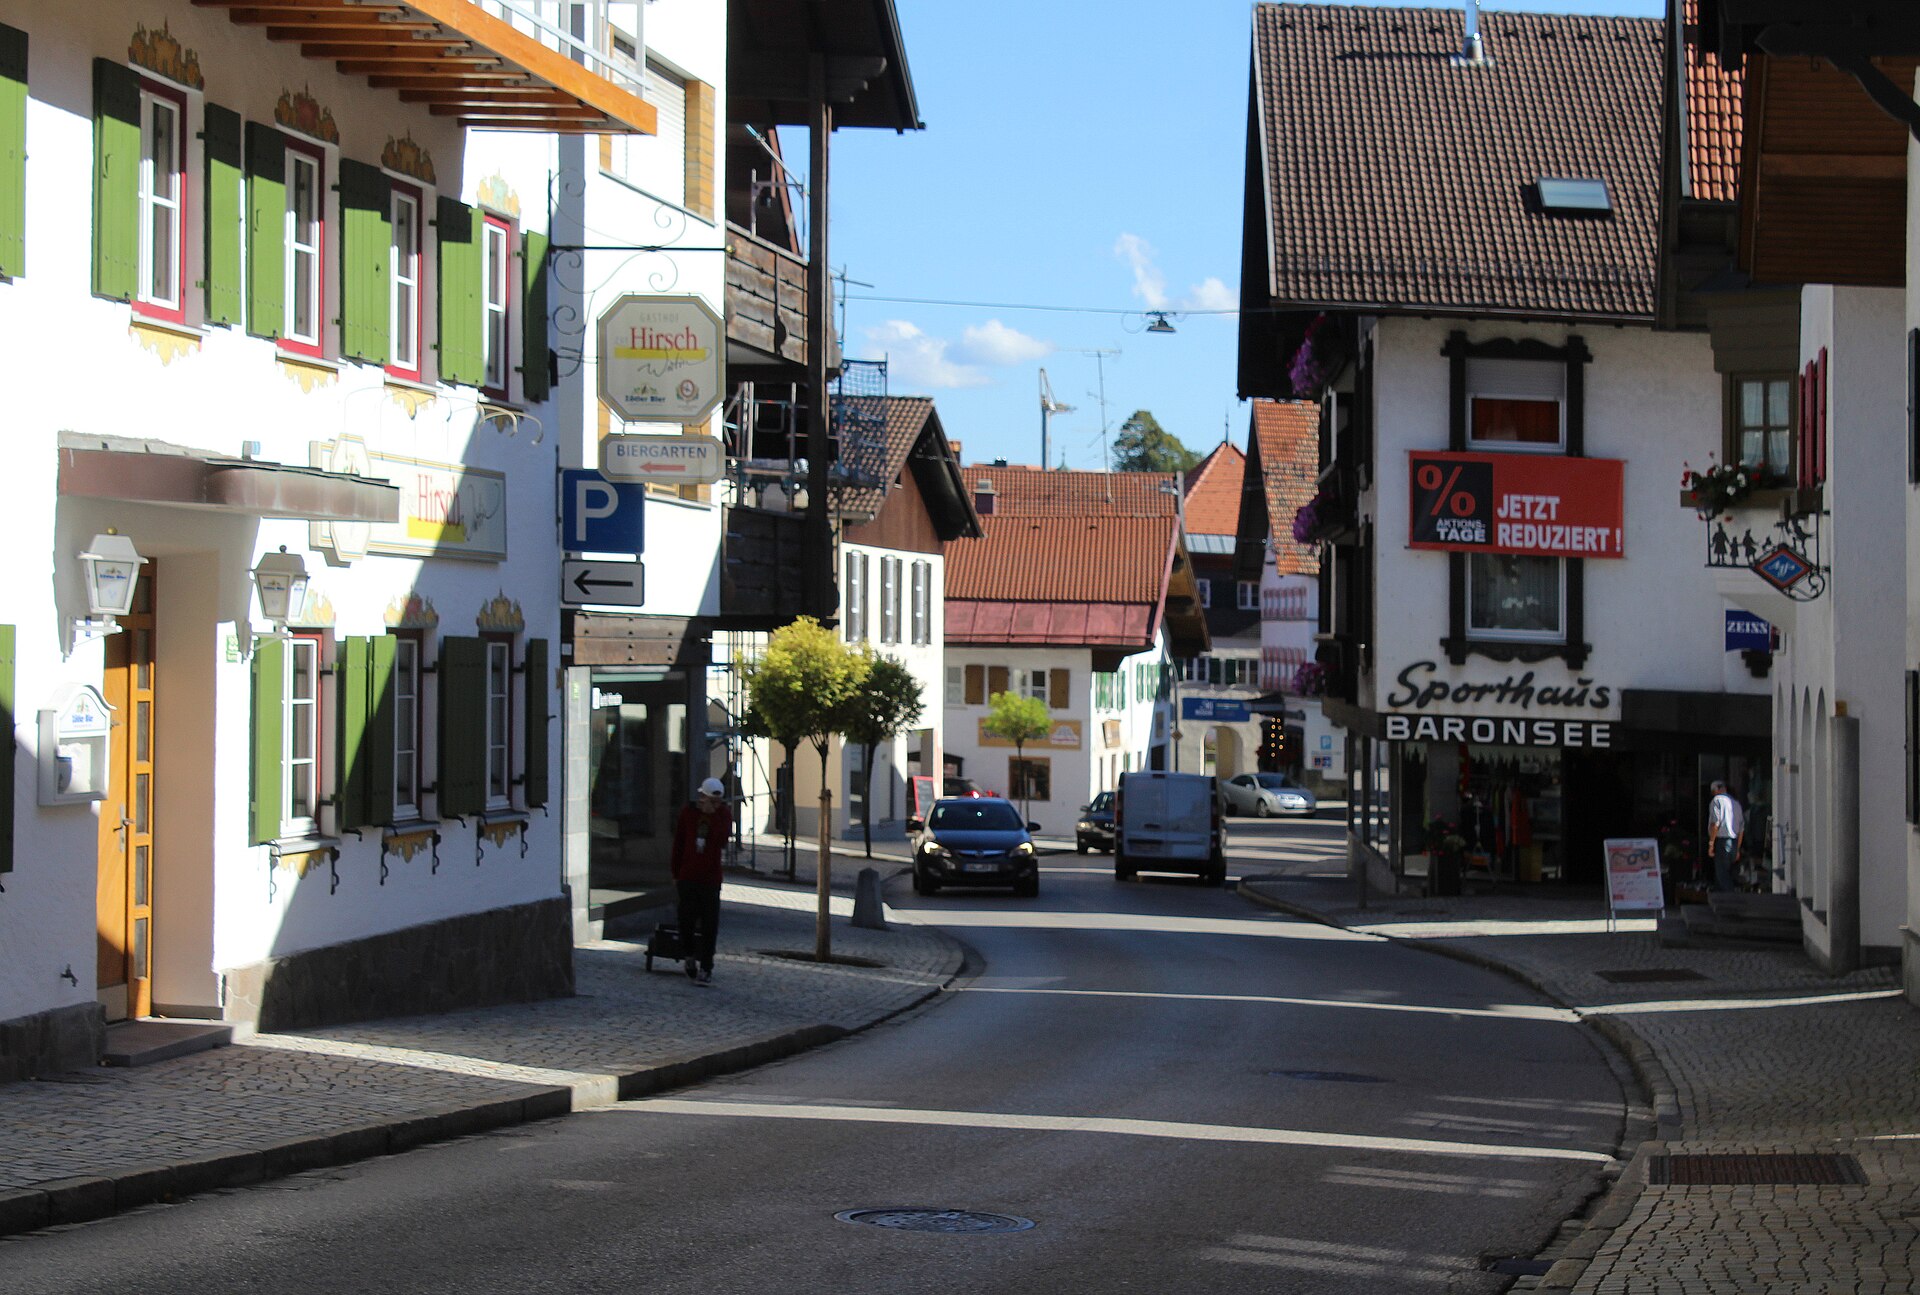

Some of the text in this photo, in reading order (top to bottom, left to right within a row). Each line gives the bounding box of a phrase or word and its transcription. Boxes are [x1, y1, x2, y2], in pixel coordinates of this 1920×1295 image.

[630, 326, 699, 351] Hirsch
[617, 444, 707, 459] BIERGARTEN
[417, 474, 460, 528] Hirsch
[1417, 465, 1476, 517] %
[576, 480, 618, 542] P
[1497, 495, 1560, 521] JETZT
[1437, 528, 1486, 543] TAGE
[1727, 620, 1768, 634] ZEISS
[1386, 716, 1611, 748] BARONSEE
